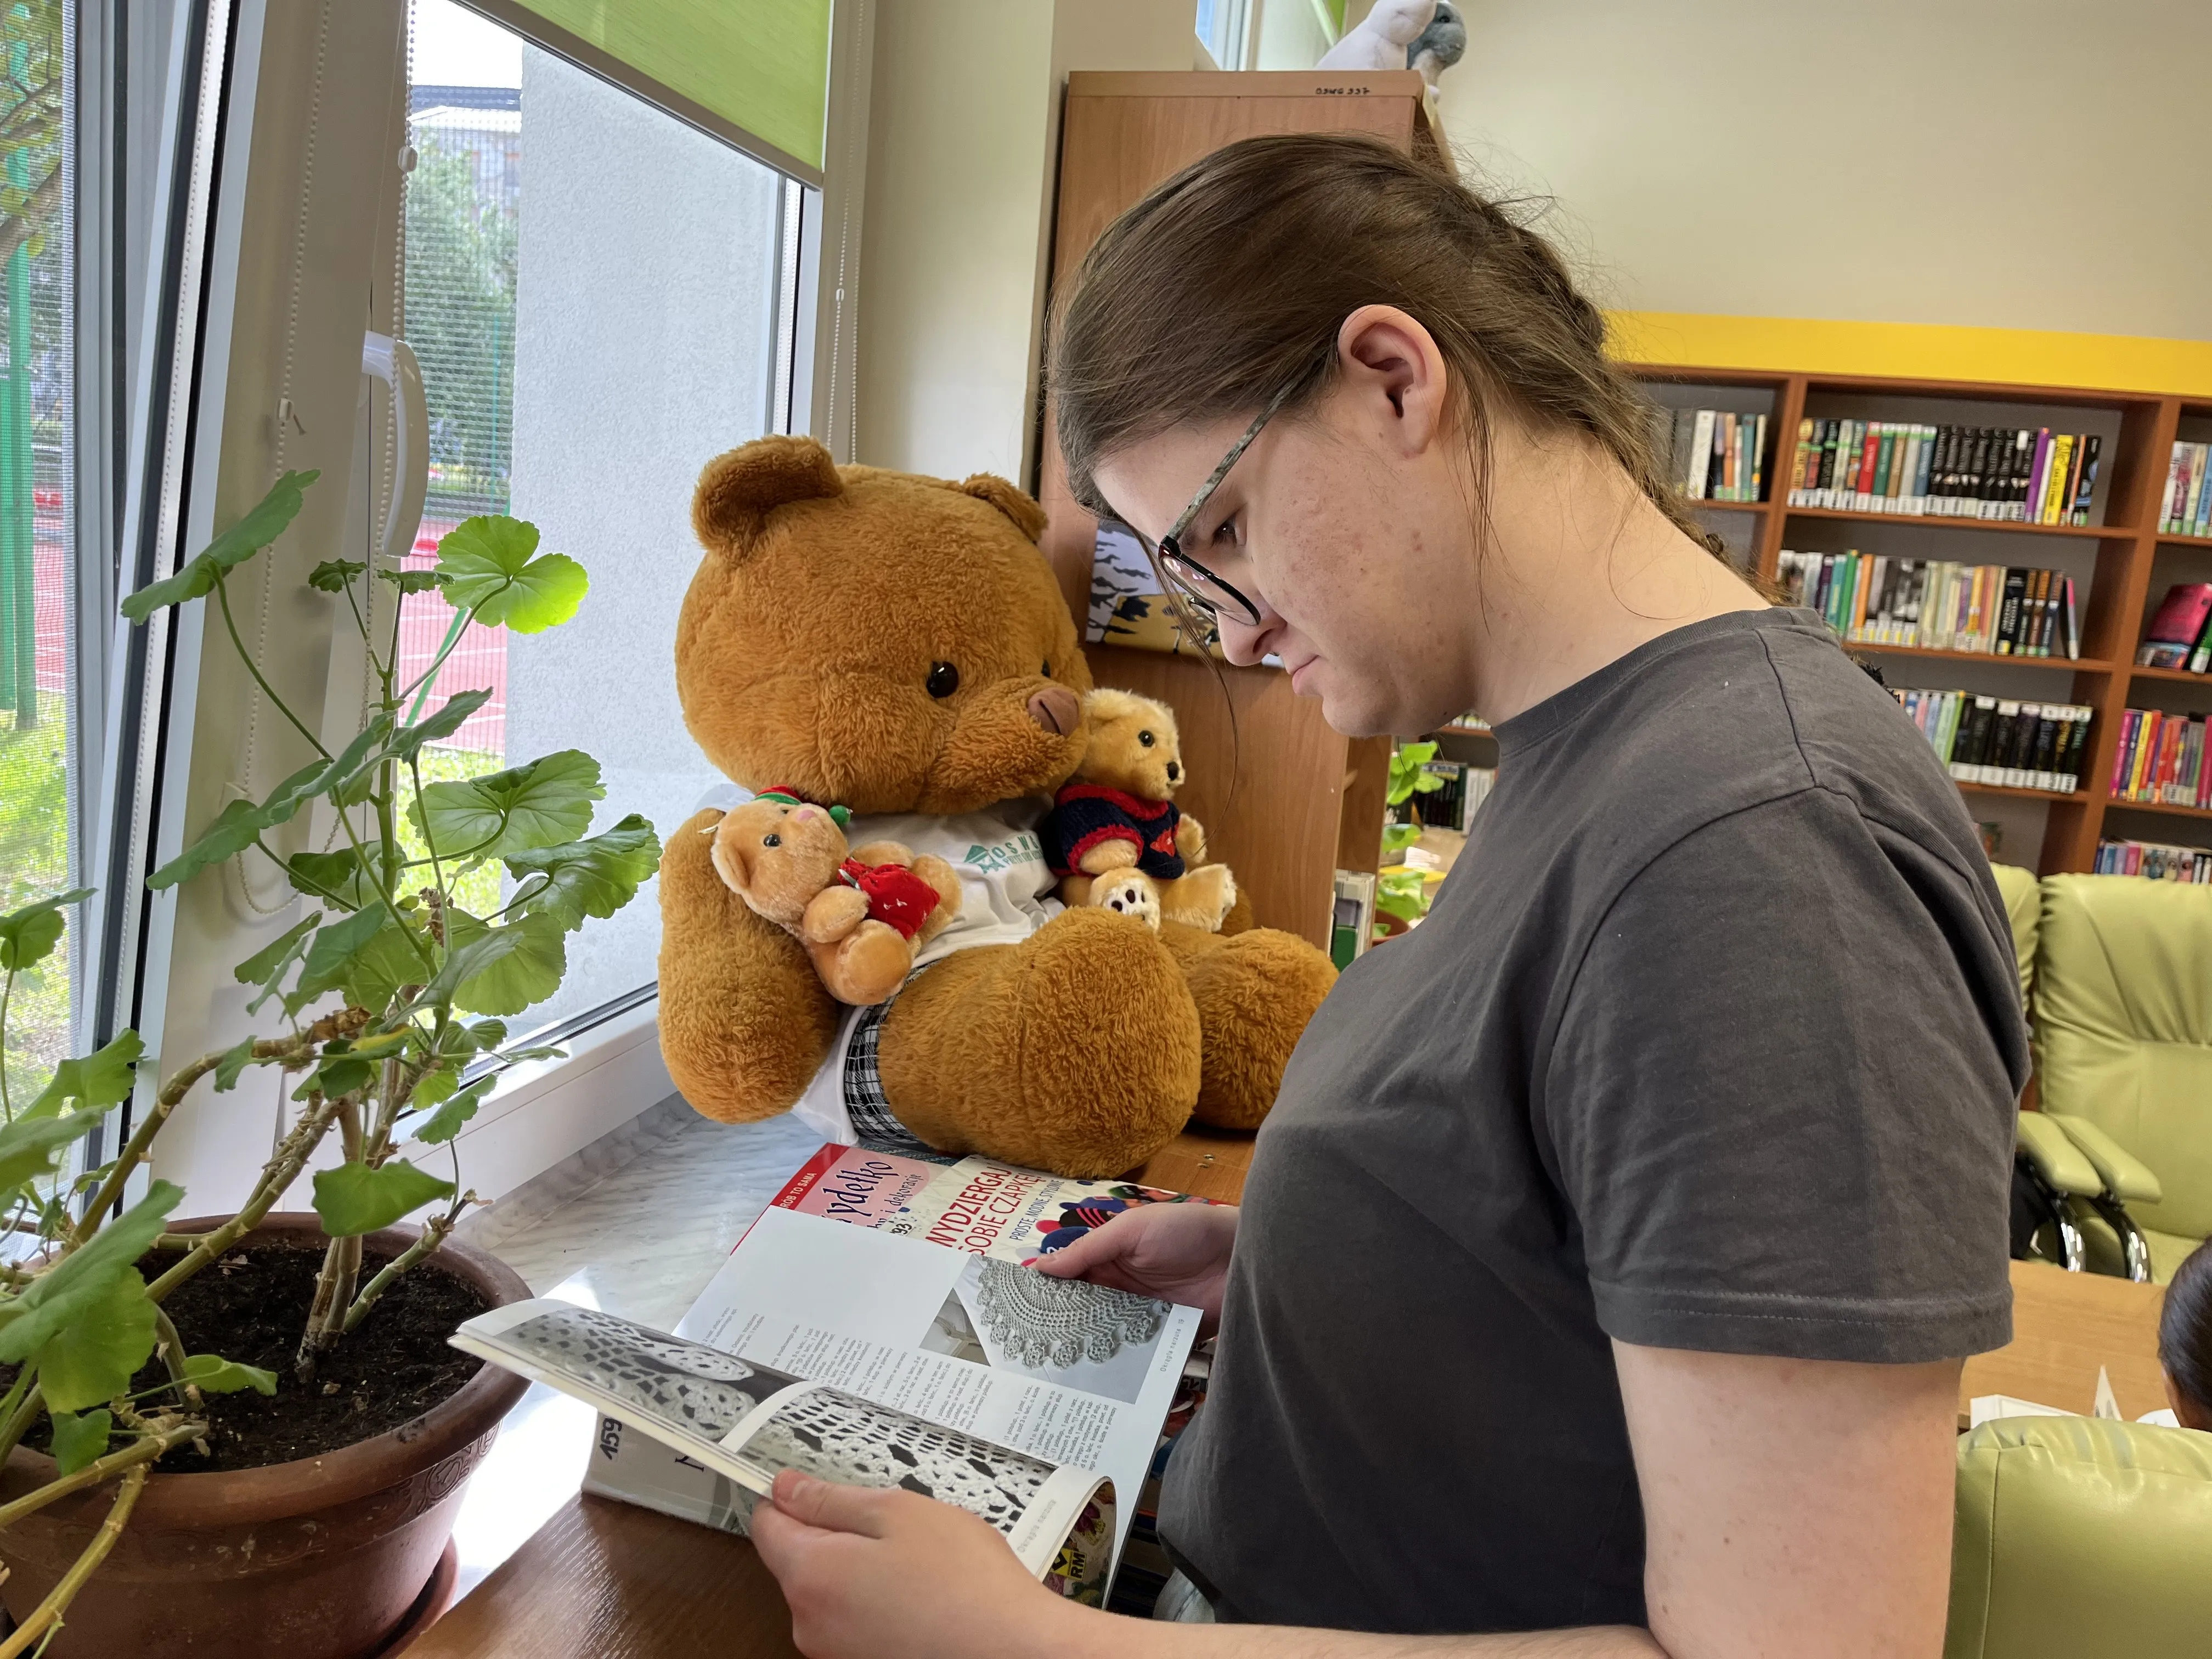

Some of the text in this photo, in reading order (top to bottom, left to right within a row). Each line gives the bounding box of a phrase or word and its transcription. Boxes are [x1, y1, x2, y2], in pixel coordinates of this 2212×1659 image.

[790, 1185, 801, 1196] TO
[797, 1172, 817, 1187] SAMA
[884, 1173, 924, 1206] dekoracje
[925, 1166, 1012, 1248] WYDZIERGAJ
[890, 1223, 912, 1235] 93
[600, 1418, 622, 1460] 159
